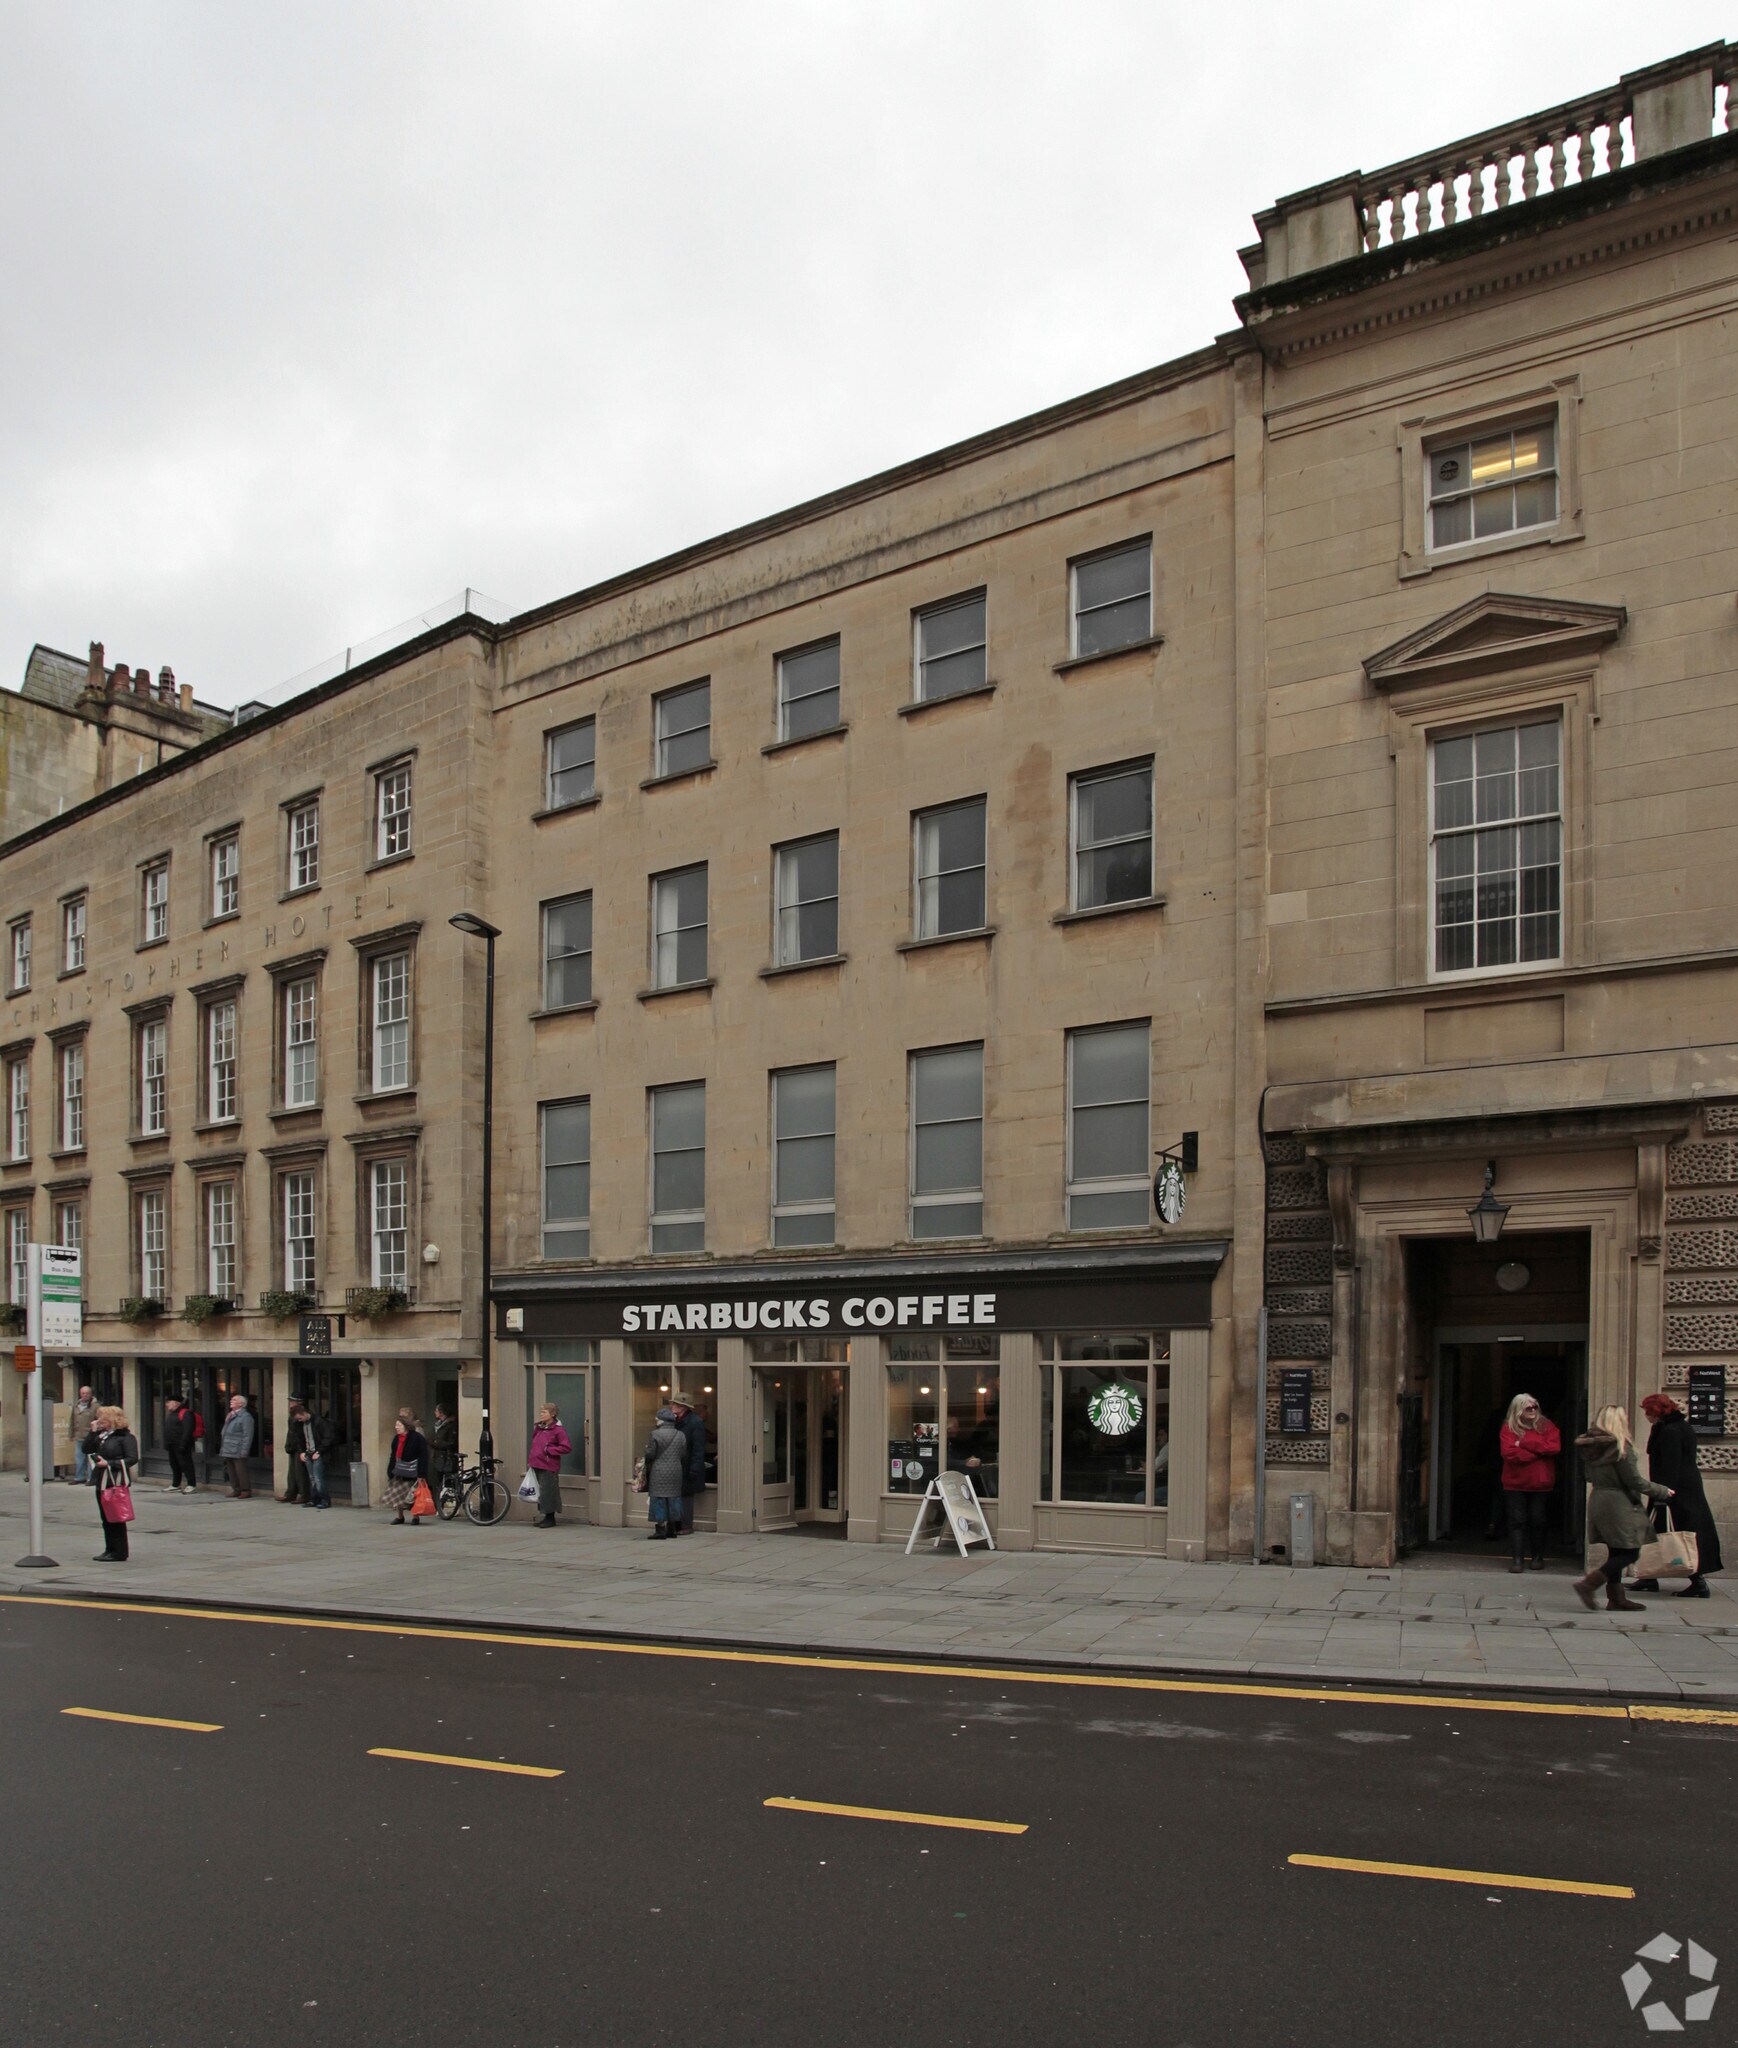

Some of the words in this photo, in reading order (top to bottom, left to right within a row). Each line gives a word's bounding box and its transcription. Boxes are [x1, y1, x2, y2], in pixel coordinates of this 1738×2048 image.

[13, 939, 229, 1028] CHRISTOPHER
[265, 886, 394, 947] HOTEL
[622, 1299, 830, 1331] STARBUCKS
[841, 1294, 996, 1326] COFFEE
[306, 1320, 327, 1330] ALL
[307, 1332, 327, 1342] BAR
[305, 1344, 329, 1354] ONE
